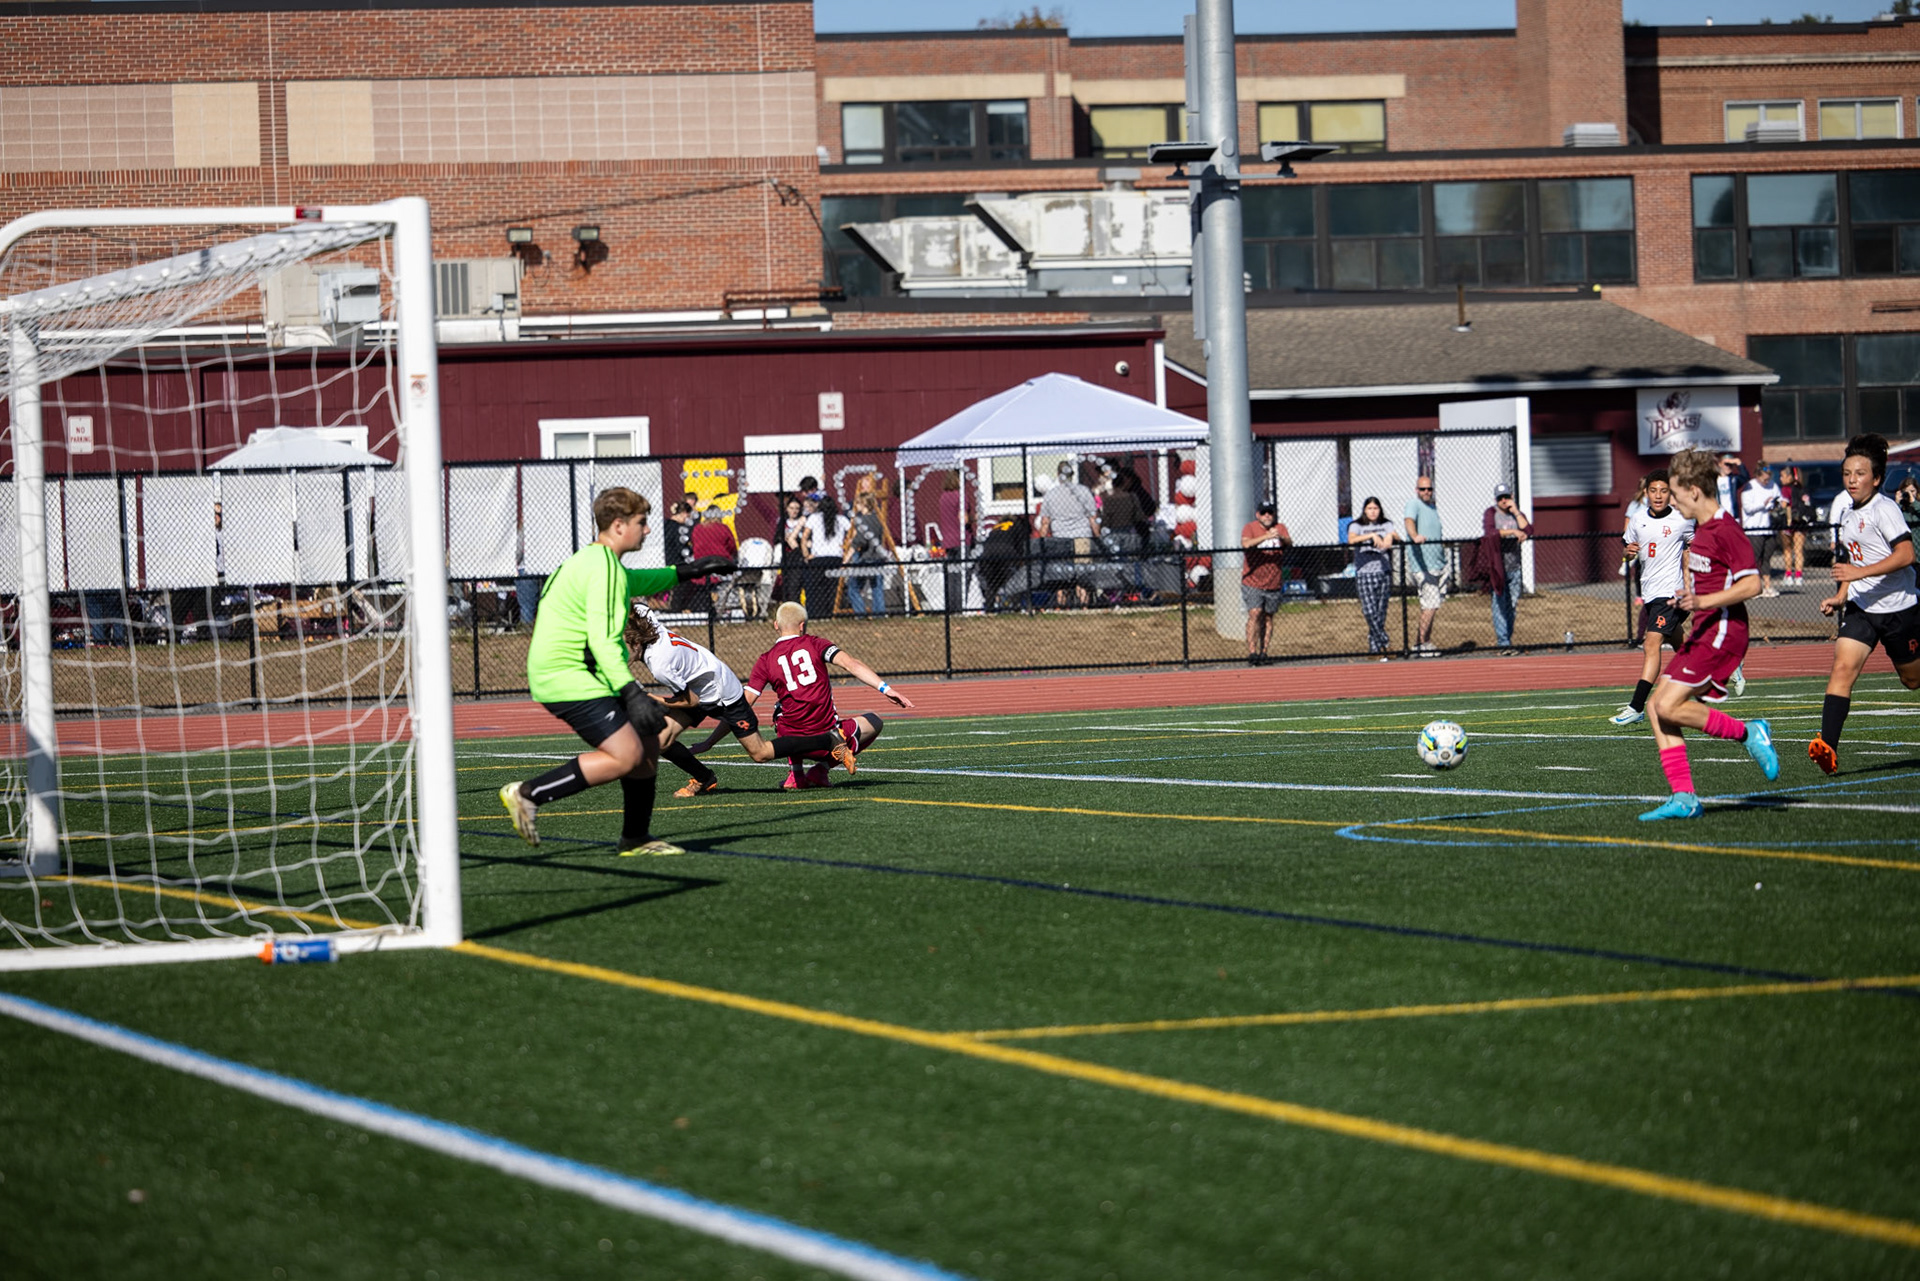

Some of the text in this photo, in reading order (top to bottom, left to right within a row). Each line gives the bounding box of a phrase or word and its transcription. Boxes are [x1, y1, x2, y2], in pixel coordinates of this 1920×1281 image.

[1653, 416, 1698, 441] RAMS
[1667, 439, 1734, 450] SNACK SHACK
[1648, 542, 1657, 558] 6
[1848, 541, 1864, 562] 13
[777, 648, 818, 692] 13
